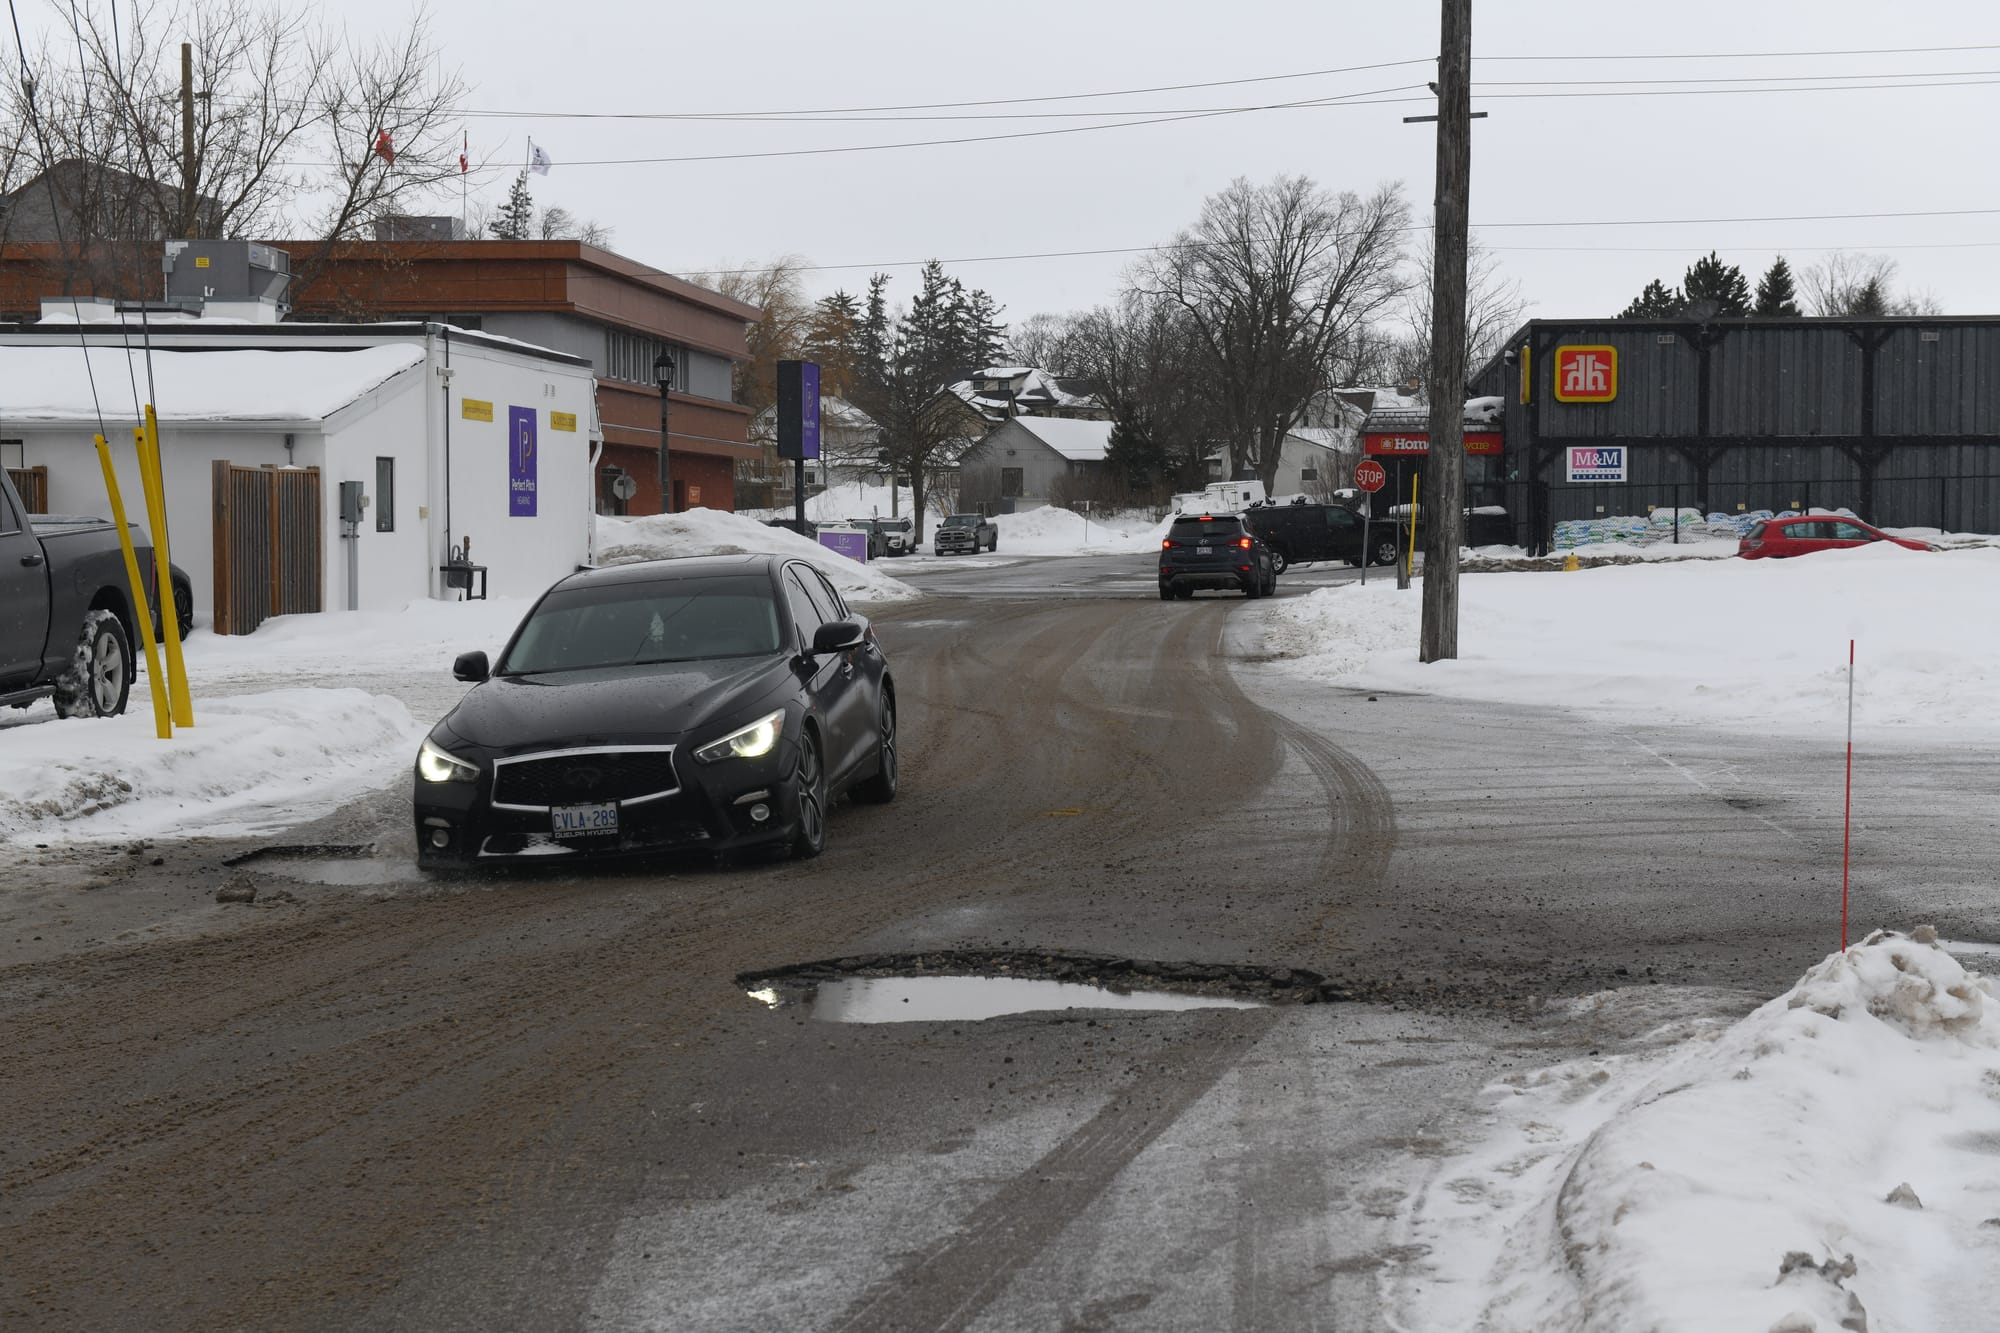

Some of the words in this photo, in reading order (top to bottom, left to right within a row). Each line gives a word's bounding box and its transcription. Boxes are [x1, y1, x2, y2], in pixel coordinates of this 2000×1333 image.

[1575, 451, 1619, 466] M&M
[1357, 469, 1383, 483] STOP
[553, 812, 585, 830] CVLA
[593, 810, 617, 827] 289
